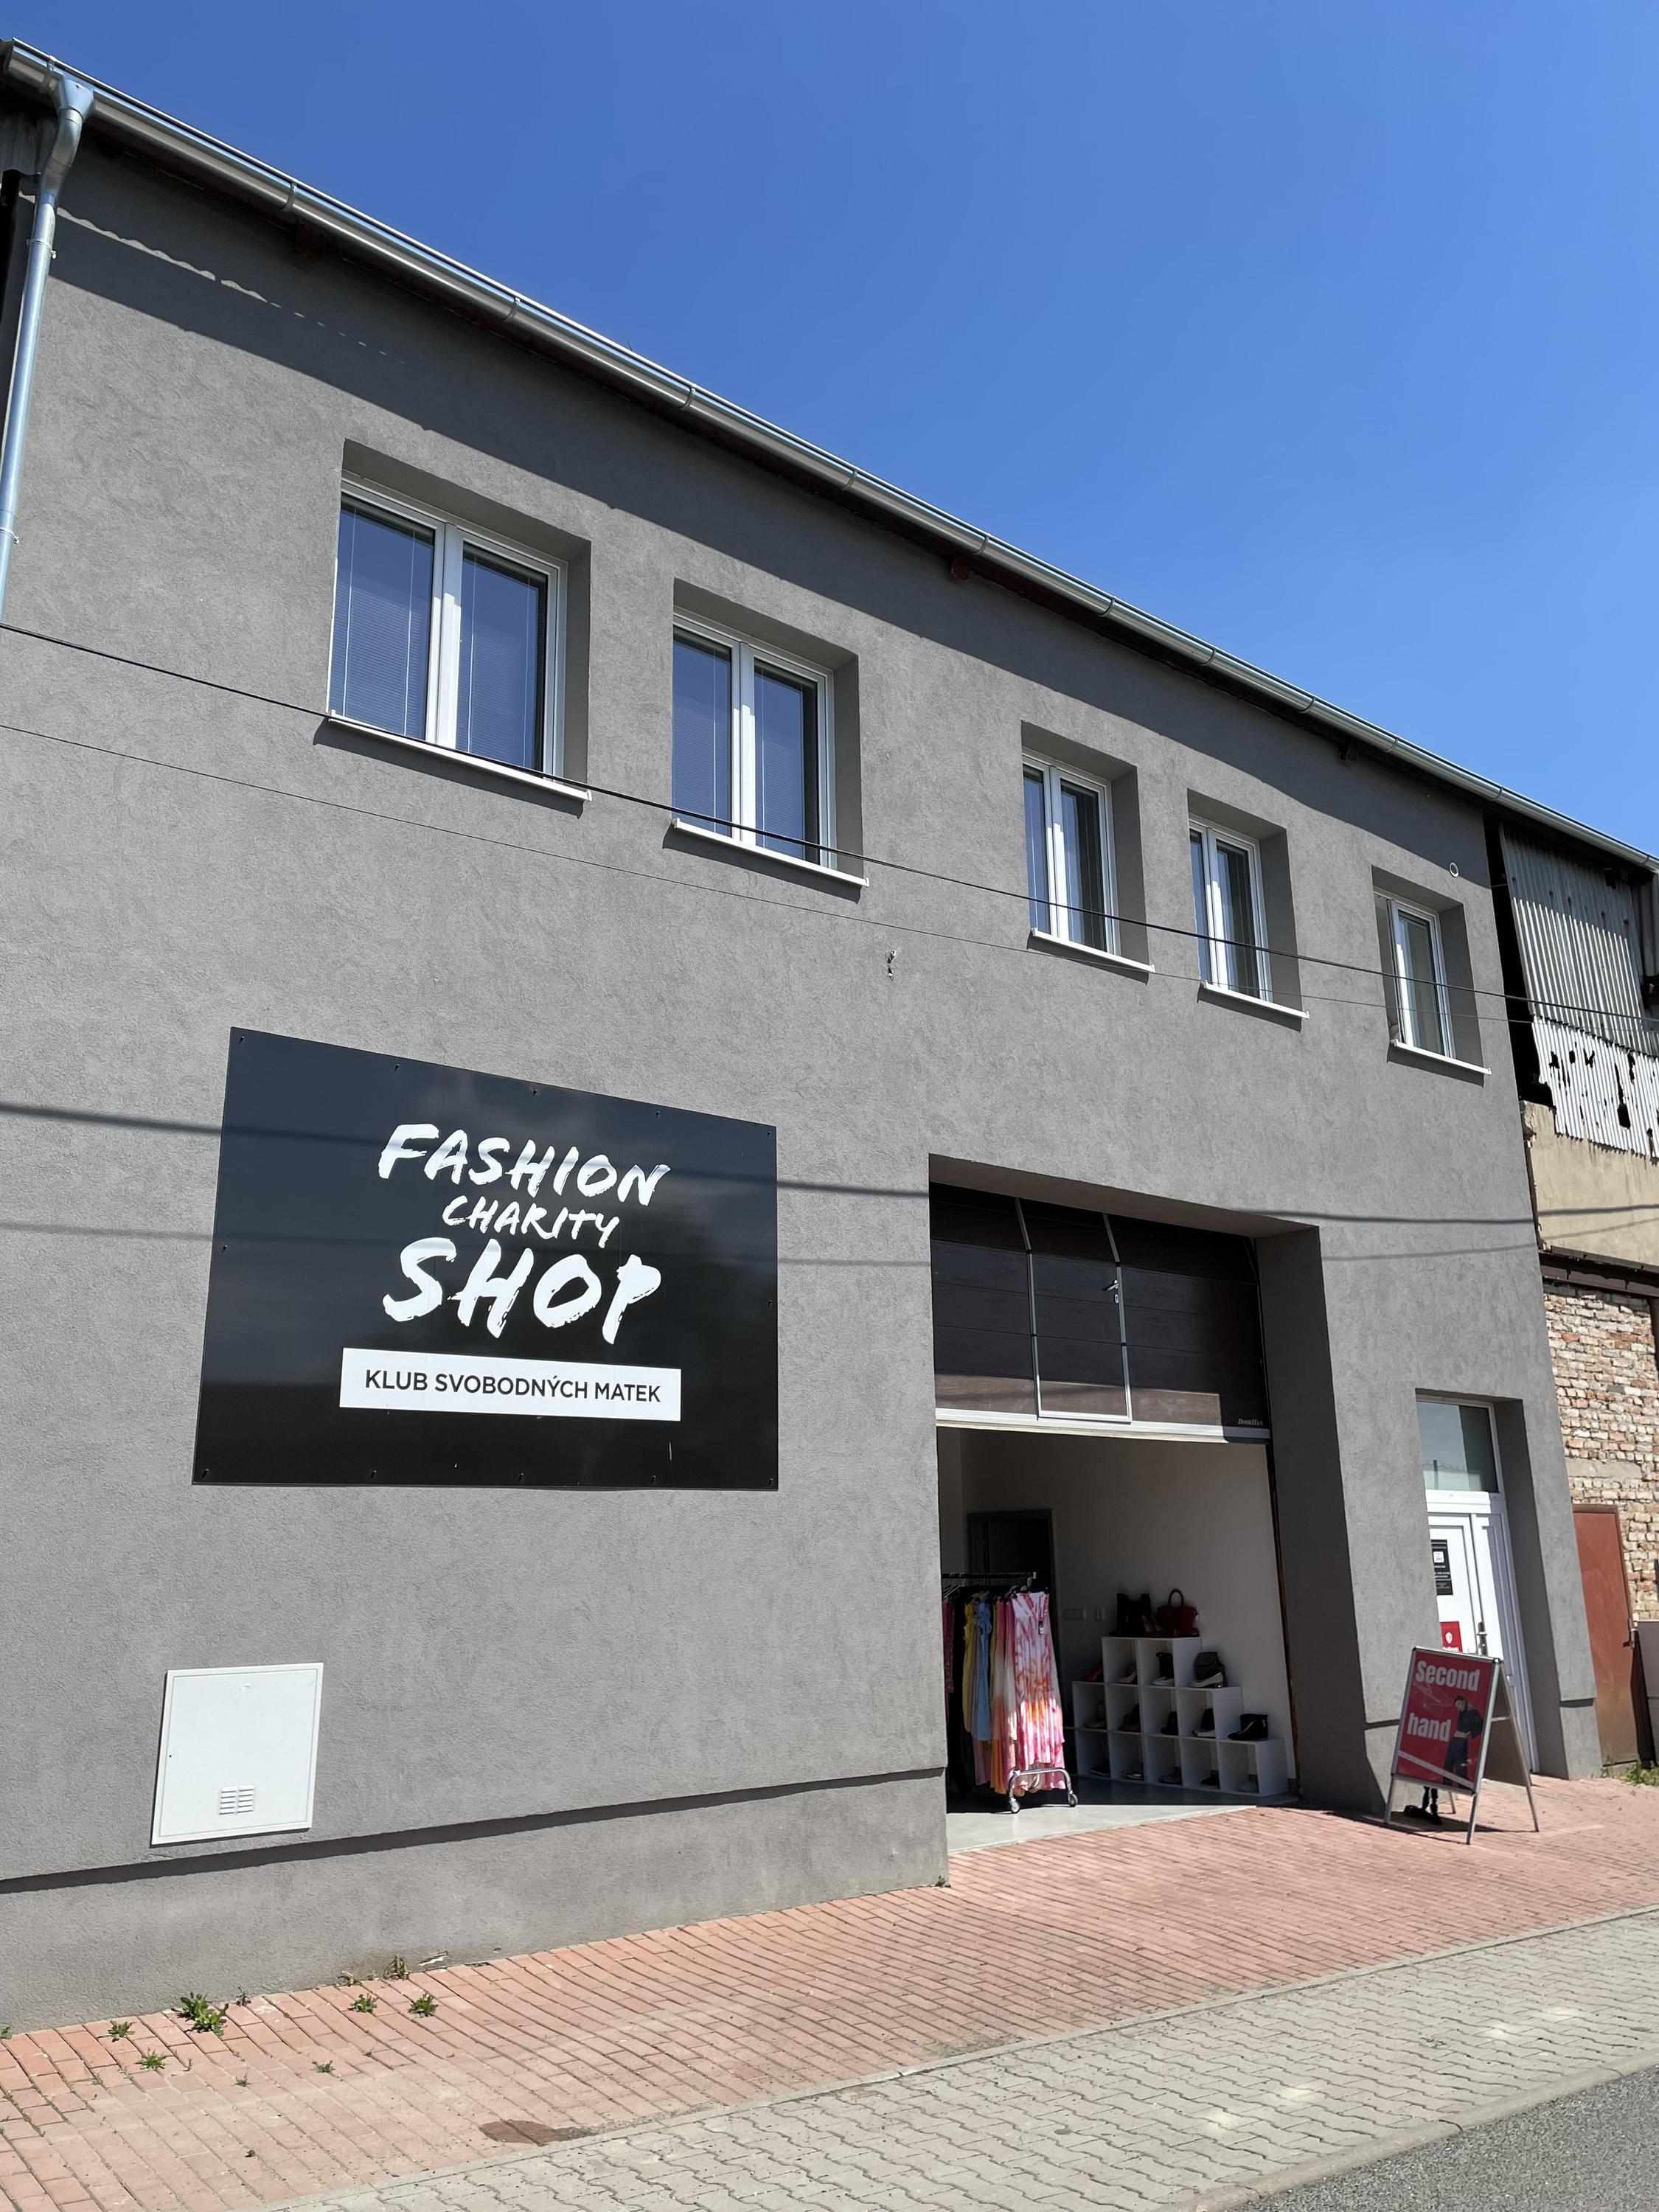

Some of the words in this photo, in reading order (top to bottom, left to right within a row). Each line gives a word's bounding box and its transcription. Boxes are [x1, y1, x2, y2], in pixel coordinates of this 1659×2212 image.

[378, 1123, 672, 1206] FASHION
[442, 1194, 620, 1248] CHARITY
[382, 1237, 661, 1345] SHOP
[365, 1369, 428, 1391] KLUB
[434, 1373, 589, 1399] SVOBODNÝCH
[594, 1382, 661, 1402] MATEK
[1415, 1660, 1481, 1691] Second
[1407, 1712, 1452, 1742] hand
